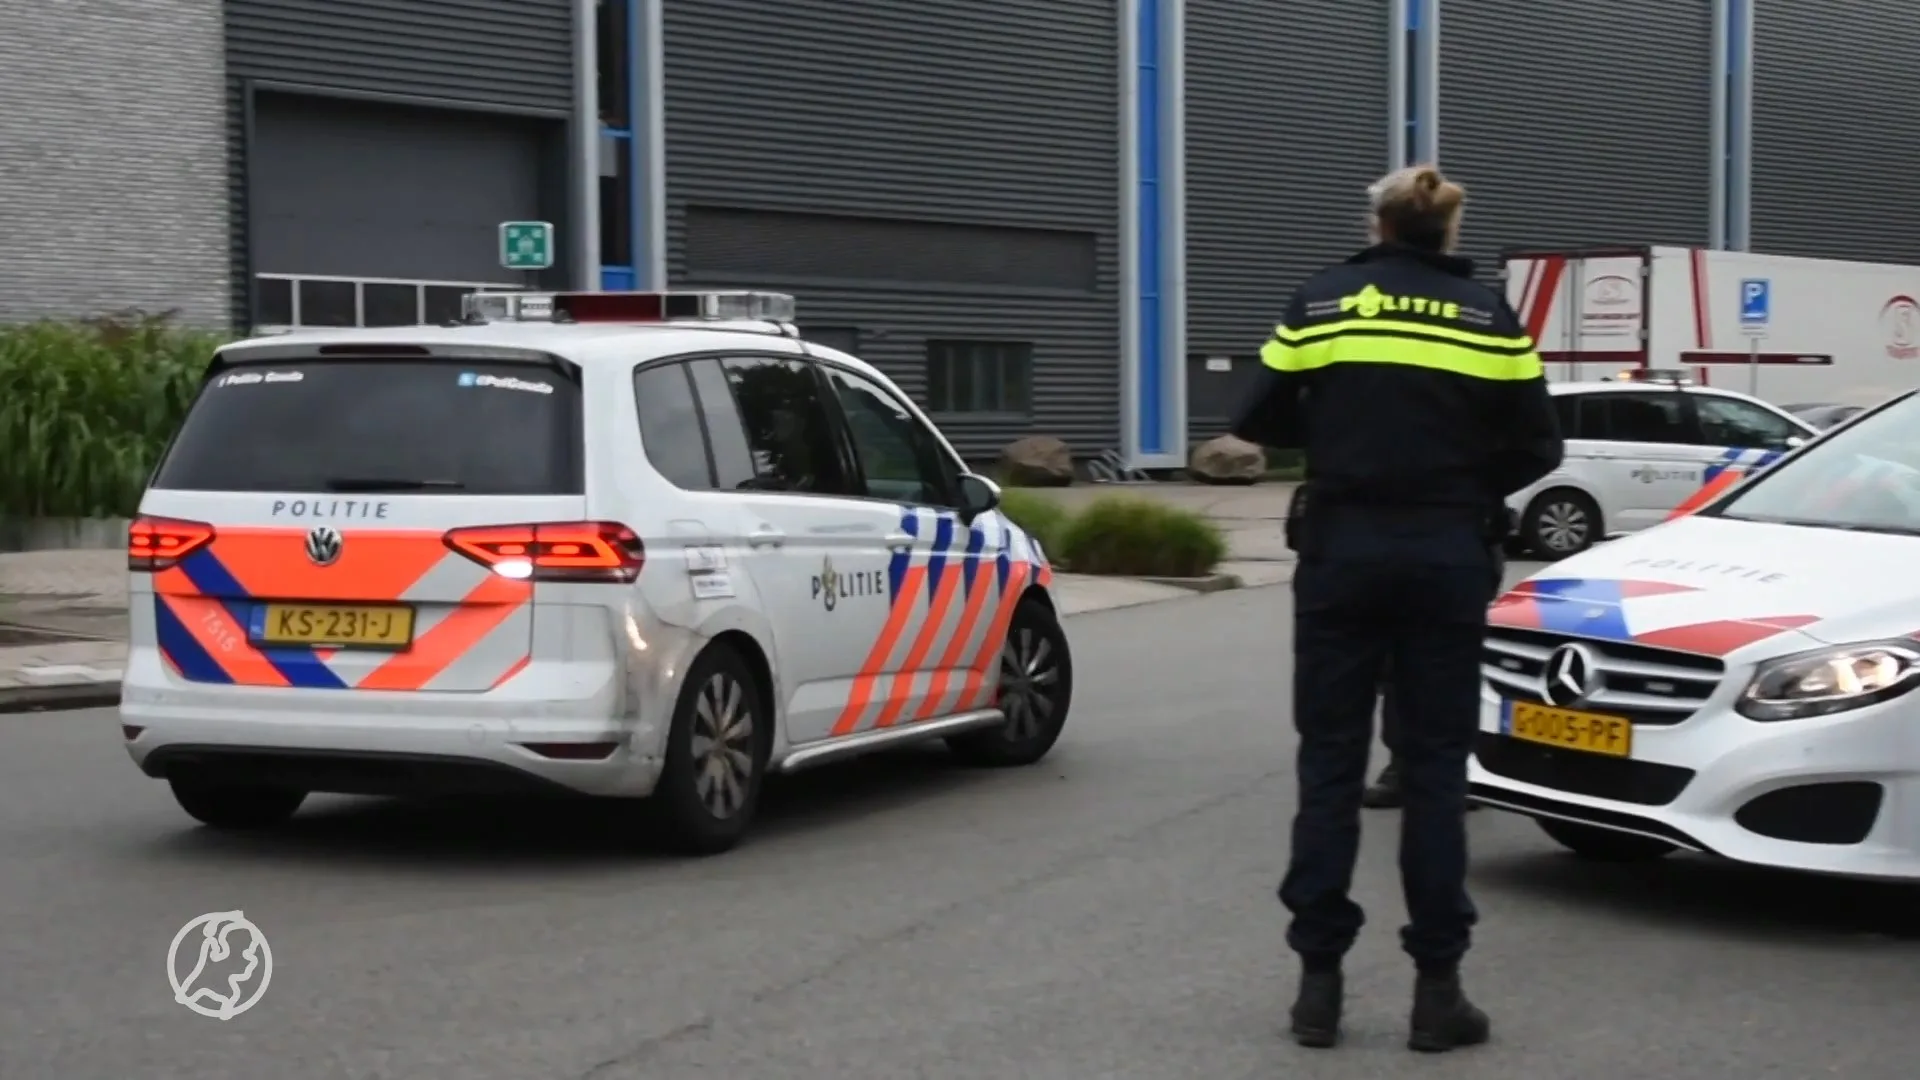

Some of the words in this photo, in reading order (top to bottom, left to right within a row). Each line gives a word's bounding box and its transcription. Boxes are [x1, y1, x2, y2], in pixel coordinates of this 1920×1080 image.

[1339, 289, 1459, 318] POLITIE
[1745, 283, 1763, 304] P
[272, 500, 390, 519] POLITIE
[812, 569, 884, 611] POLITIE
[278, 609, 392, 638] KS-231-J
